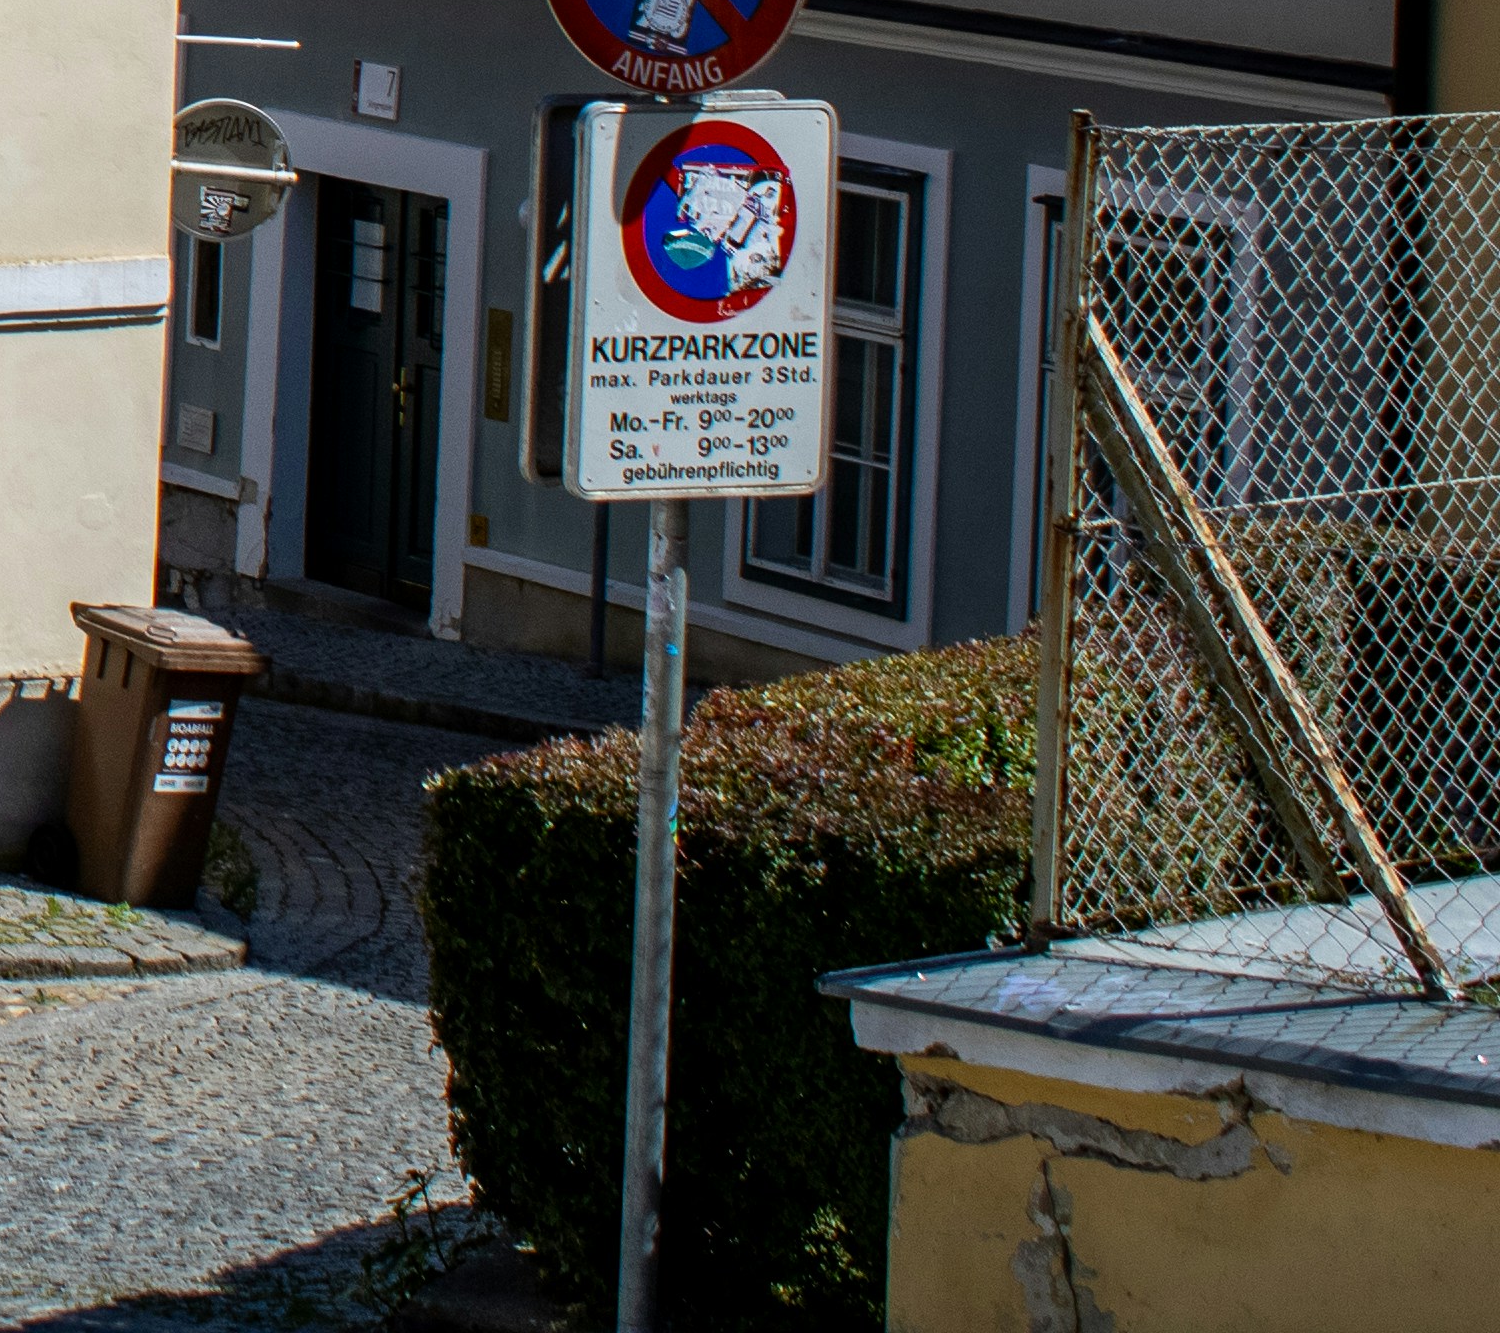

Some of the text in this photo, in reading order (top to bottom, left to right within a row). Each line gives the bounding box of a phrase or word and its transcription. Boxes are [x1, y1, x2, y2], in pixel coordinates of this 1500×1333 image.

[611, 50, 724, 91] ANFANG
[384, 69, 397, 98] 7
[590, 331, 819, 364] KURZPARKZONE
[590, 373, 638, 389] max.
[648, 367, 751, 387] Parkdauer
[669, 390, 738, 406] werktags
[608, 438, 644, 461] Sa.
[622, 461, 780, 484] gebührenpflichtig
[170, 722, 214, 735] BIOABFALL
